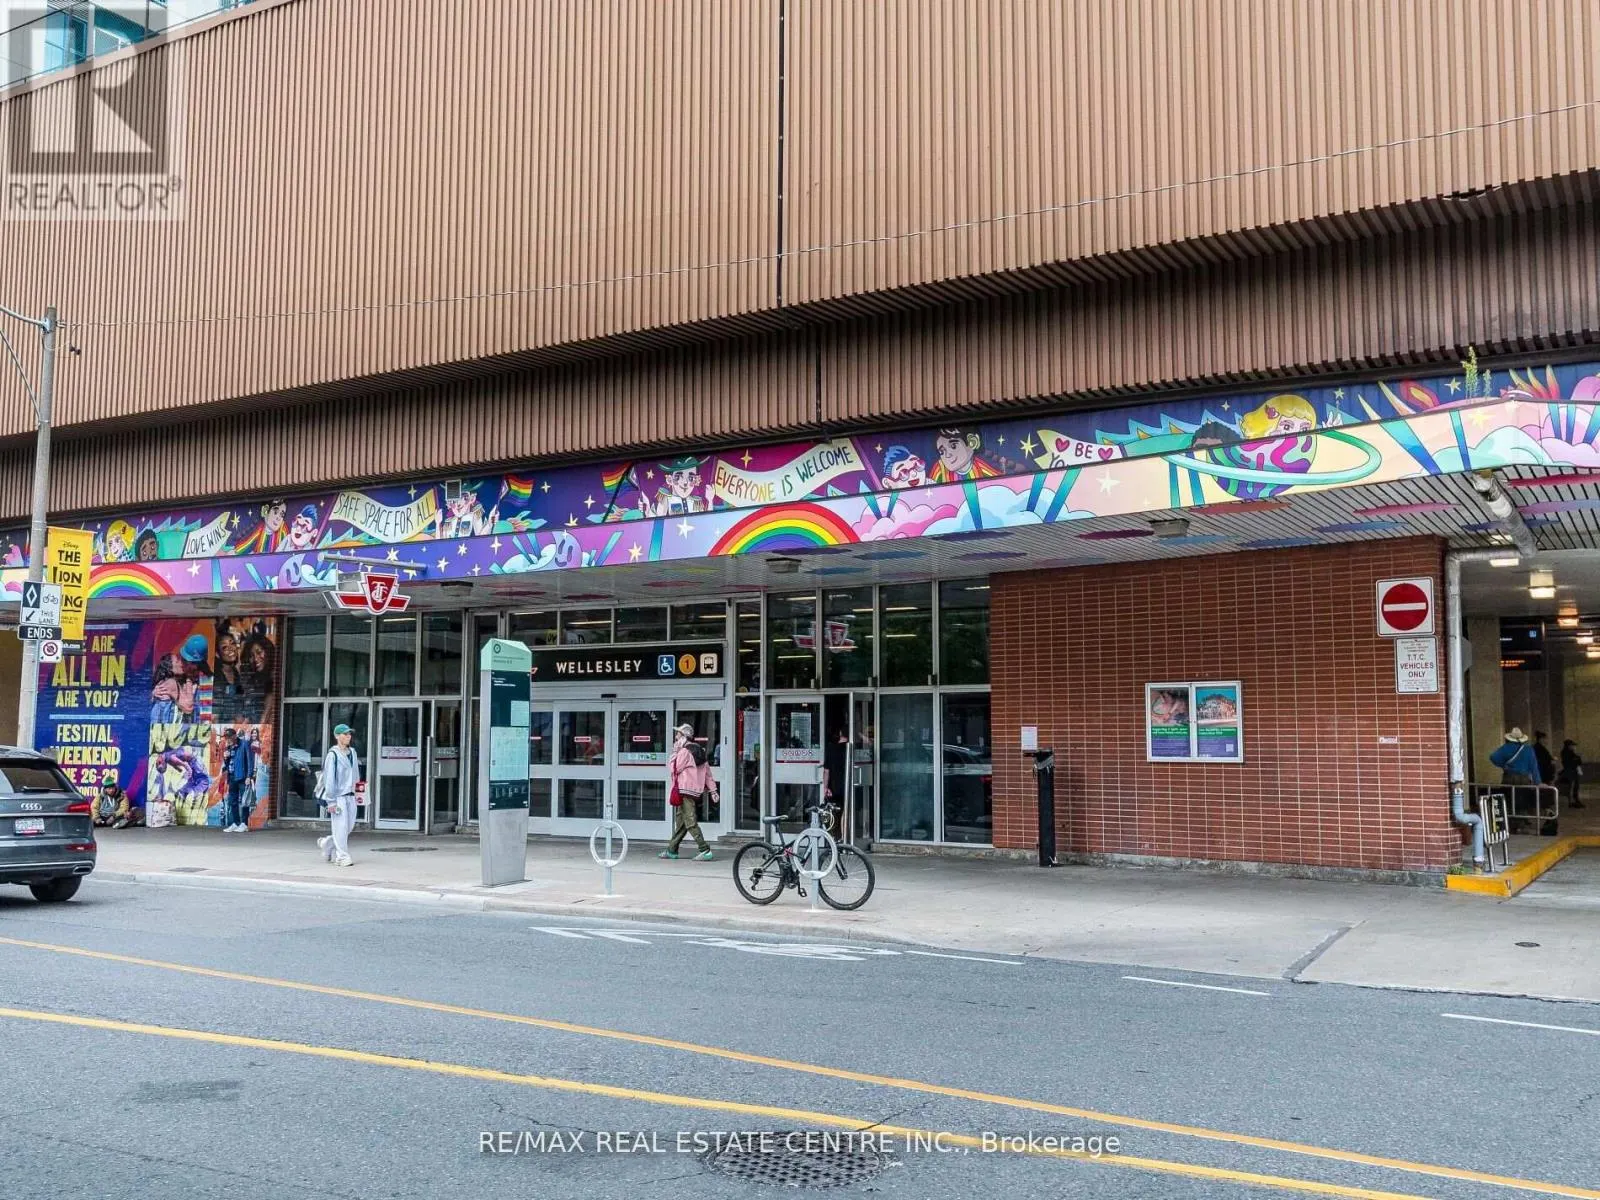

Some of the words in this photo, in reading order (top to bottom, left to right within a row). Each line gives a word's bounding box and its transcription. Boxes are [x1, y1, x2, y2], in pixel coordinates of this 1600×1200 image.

[1074, 442, 1093, 460] BE
[715, 466, 777, 502] EVERYONE
[781, 474, 794, 497] IS
[795, 446, 854, 483] WELCOME
[333, 493, 360, 520] SAFE
[360, 501, 393, 537] SPACE
[393, 508, 414, 537] FOR
[416, 498, 436, 526] ALL
[186, 535, 207, 555] LOVE
[206, 521, 227, 549] WINS
[58, 550, 81, 563] THE
[41, 609, 54, 618] THIS
[27, 627, 53, 639] ENDS
[91, 635, 116, 653] ARE
[52, 655, 92, 687] ALL
[100, 655, 126, 687] IN
[556, 659, 643, 674] WELLESLEY
[684, 654, 691, 669] 1
[1400, 662, 1434, 670] VEHICLES
[56, 690, 80, 708] ARE
[84, 690, 119, 708] YOU?
[56, 724, 114, 743] FESTIVAL
[80, 768, 119, 784] 26-29
